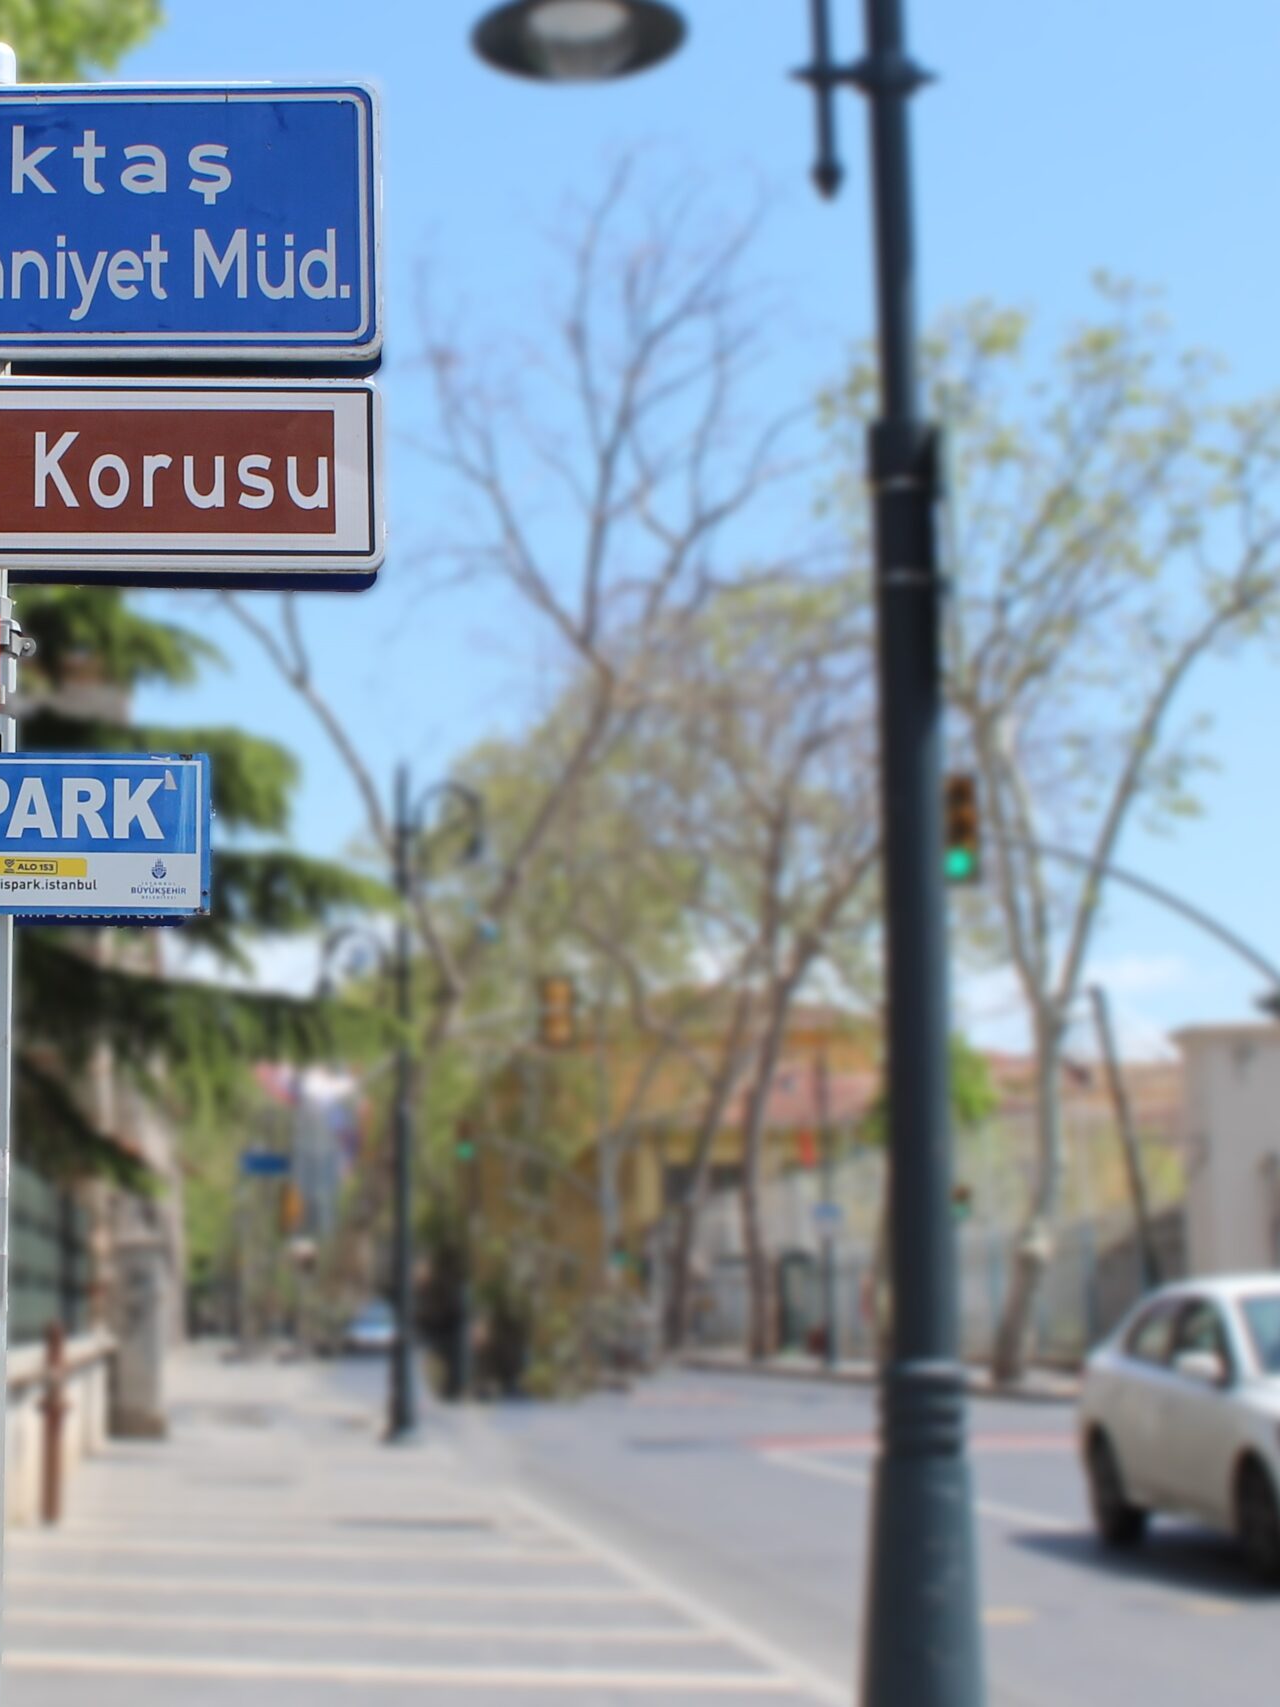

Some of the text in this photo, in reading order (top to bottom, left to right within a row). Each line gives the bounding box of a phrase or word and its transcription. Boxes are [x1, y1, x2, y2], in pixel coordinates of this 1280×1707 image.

[193, 228, 351, 300] Müd.
[34, 431, 330, 510] Korusu
[18, 863, 37, 871] ALO
